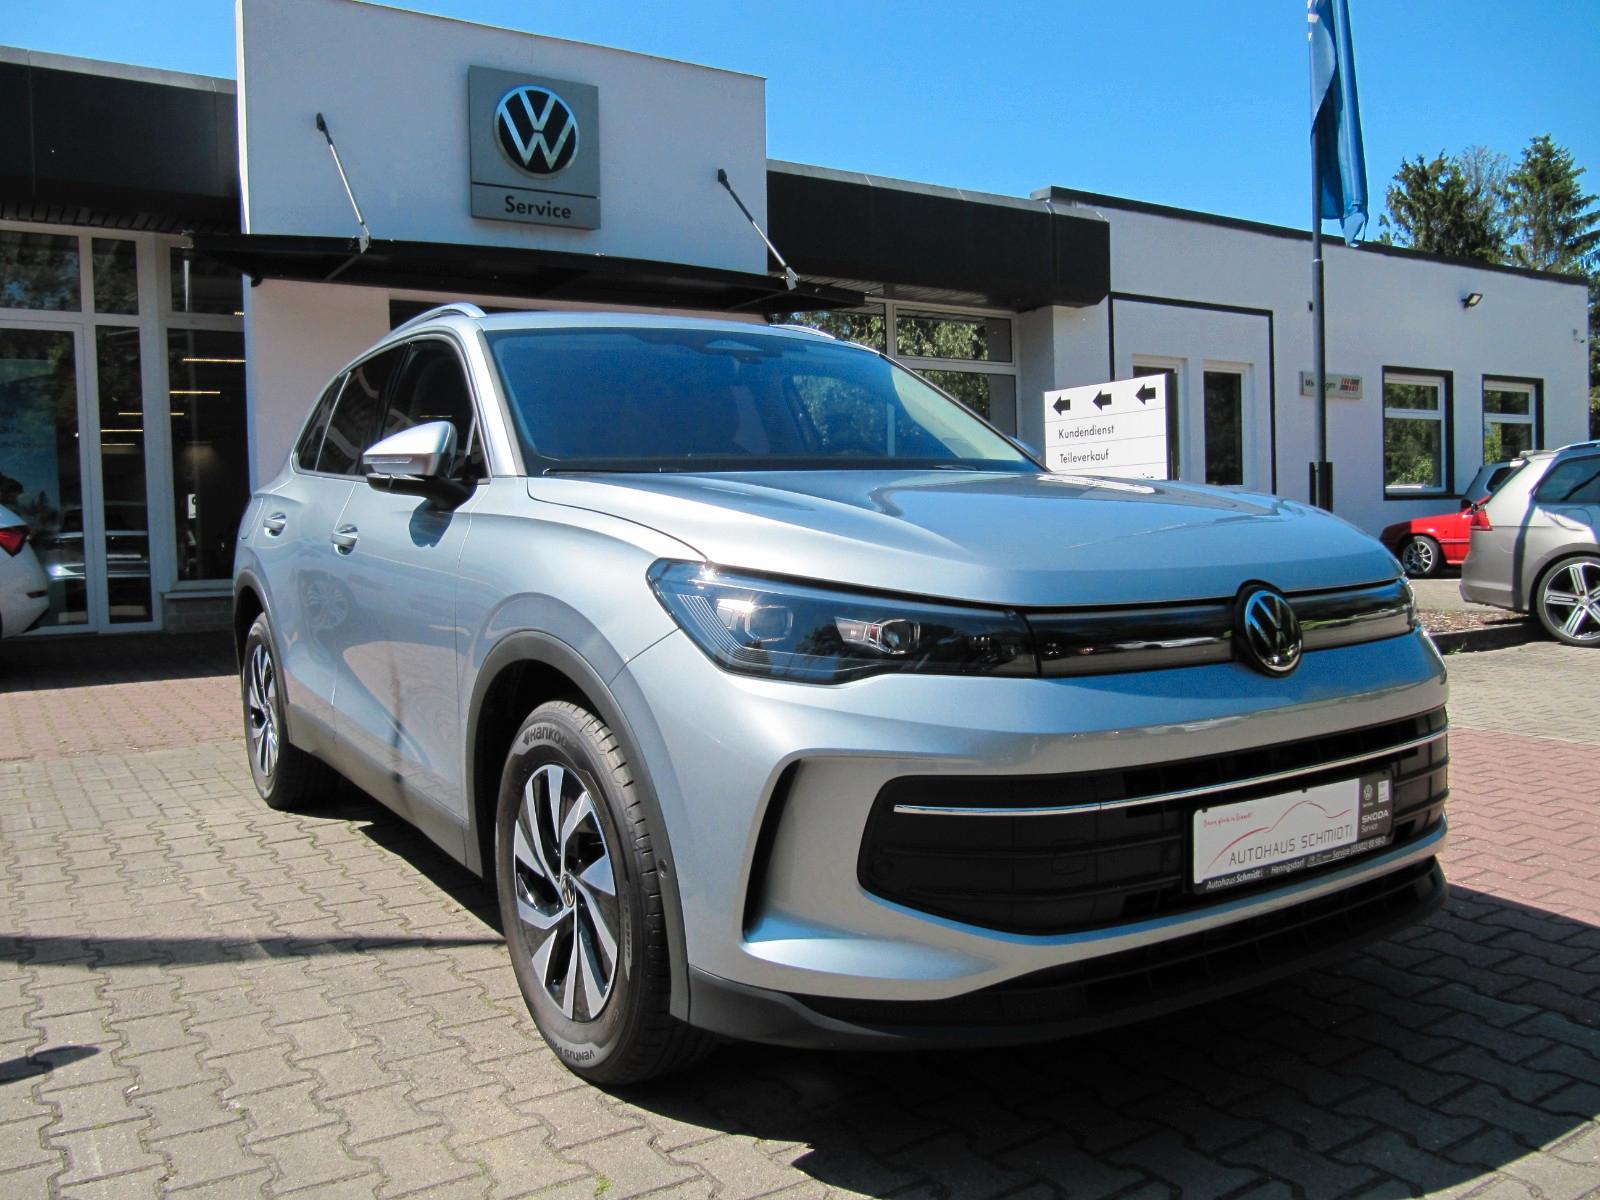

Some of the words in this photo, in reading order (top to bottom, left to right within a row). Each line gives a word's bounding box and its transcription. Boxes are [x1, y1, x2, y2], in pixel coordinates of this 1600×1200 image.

[505, 195, 572, 219] Service
[1058, 424, 1115, 440] Kundendienst
[1060, 448, 1109, 464] Teileverkauf
[1229, 838, 1296, 867] AUTOHAUS
[1206, 877, 1236, 890] Autohaus
